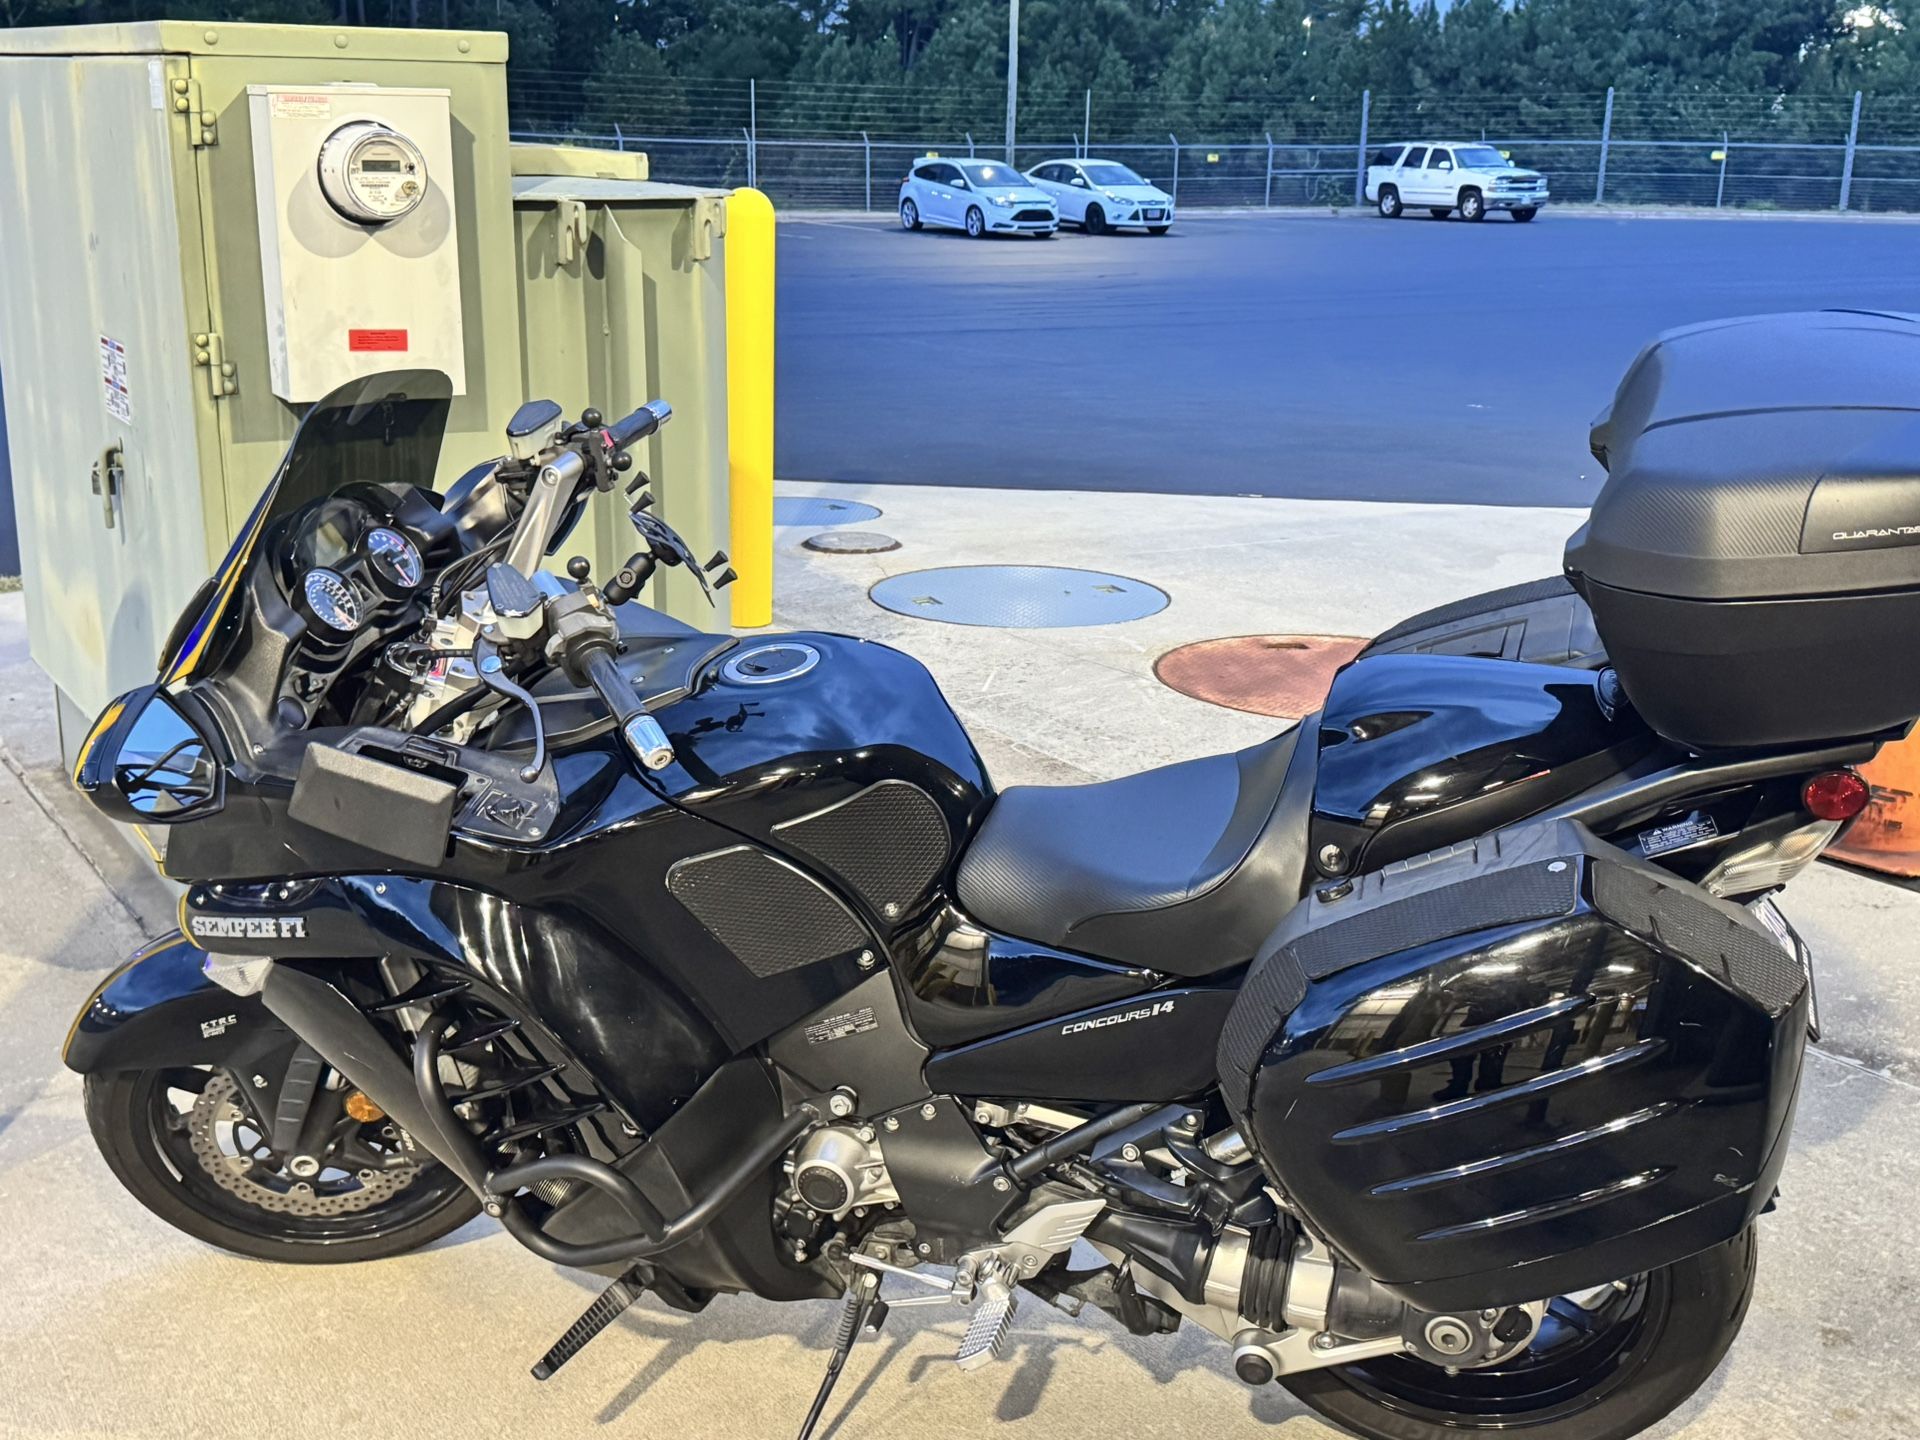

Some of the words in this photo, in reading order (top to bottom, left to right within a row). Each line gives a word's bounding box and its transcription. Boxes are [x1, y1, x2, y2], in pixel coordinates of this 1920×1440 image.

[1662, 820, 1694, 832] WARNING
[191, 915, 277, 938] SEMPER
[279, 917, 306, 938] FI
[1061, 1008, 1151, 1035] CONCOURS
[1151, 1000, 1175, 1016] 14
